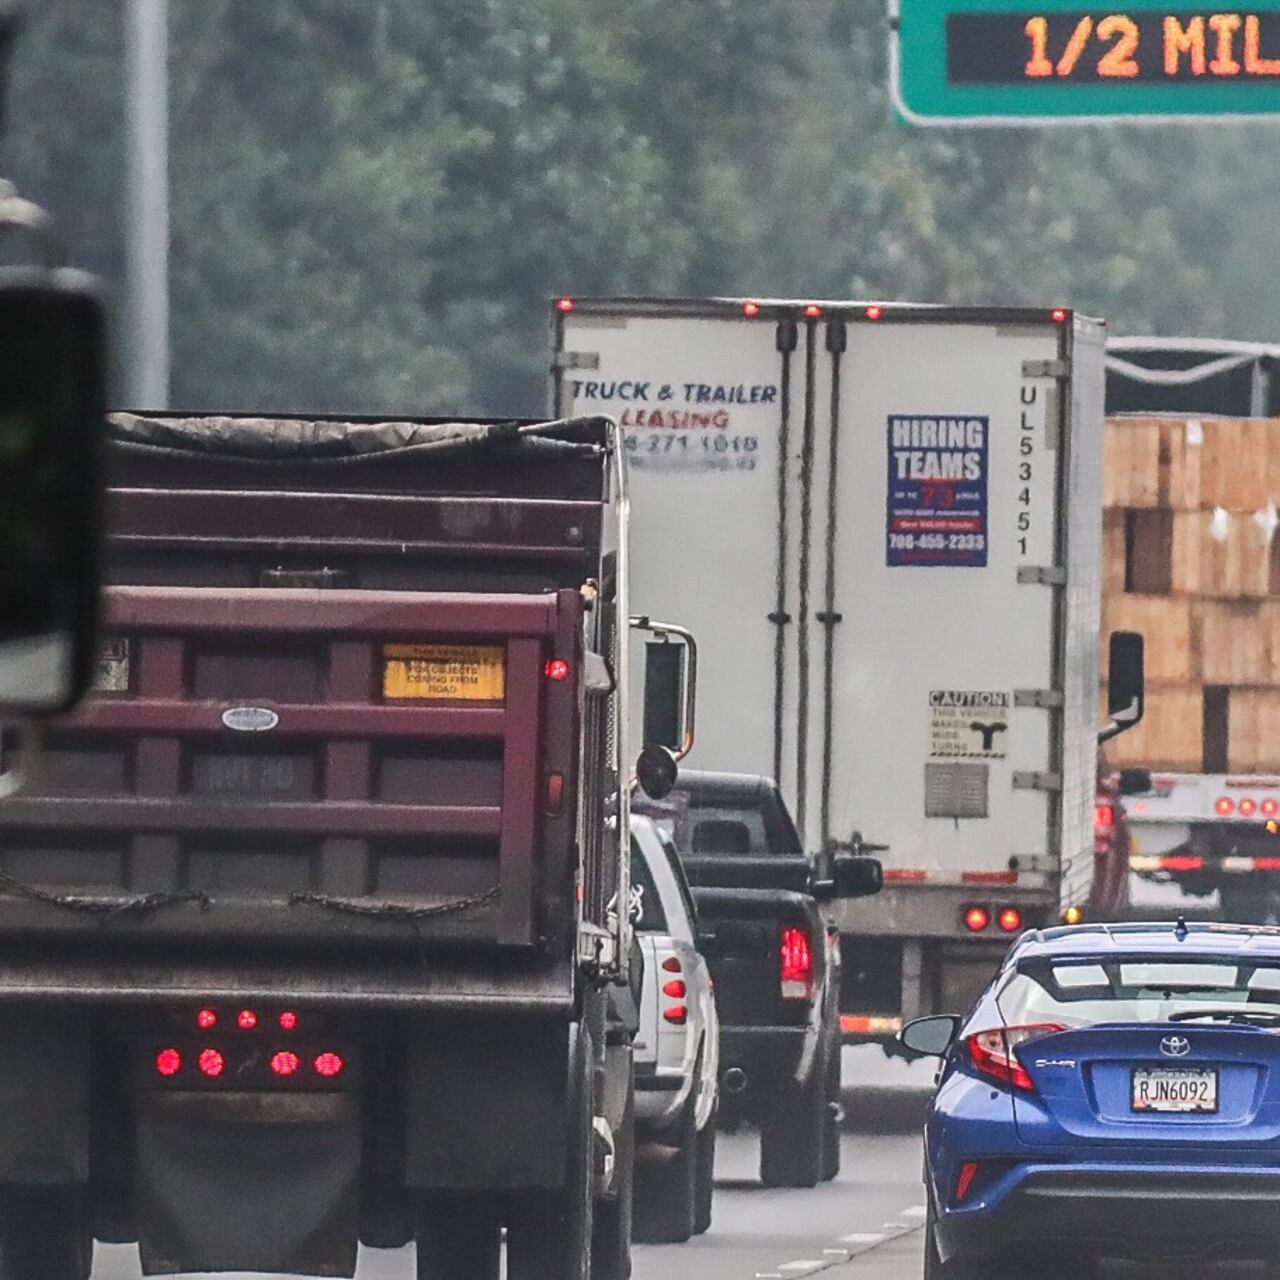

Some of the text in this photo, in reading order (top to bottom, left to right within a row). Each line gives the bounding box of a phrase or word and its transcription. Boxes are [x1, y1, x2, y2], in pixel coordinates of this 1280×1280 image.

[1024, 15, 1139, 78] 1/2
[572, 380, 777, 404] TRUCK & TRAILER
[621, 407, 730, 430] LEASING
[892, 419, 983, 448] HIRING
[893, 450, 981, 480] TEAMS
[1140, 1080, 1209, 1102] RJN6092
